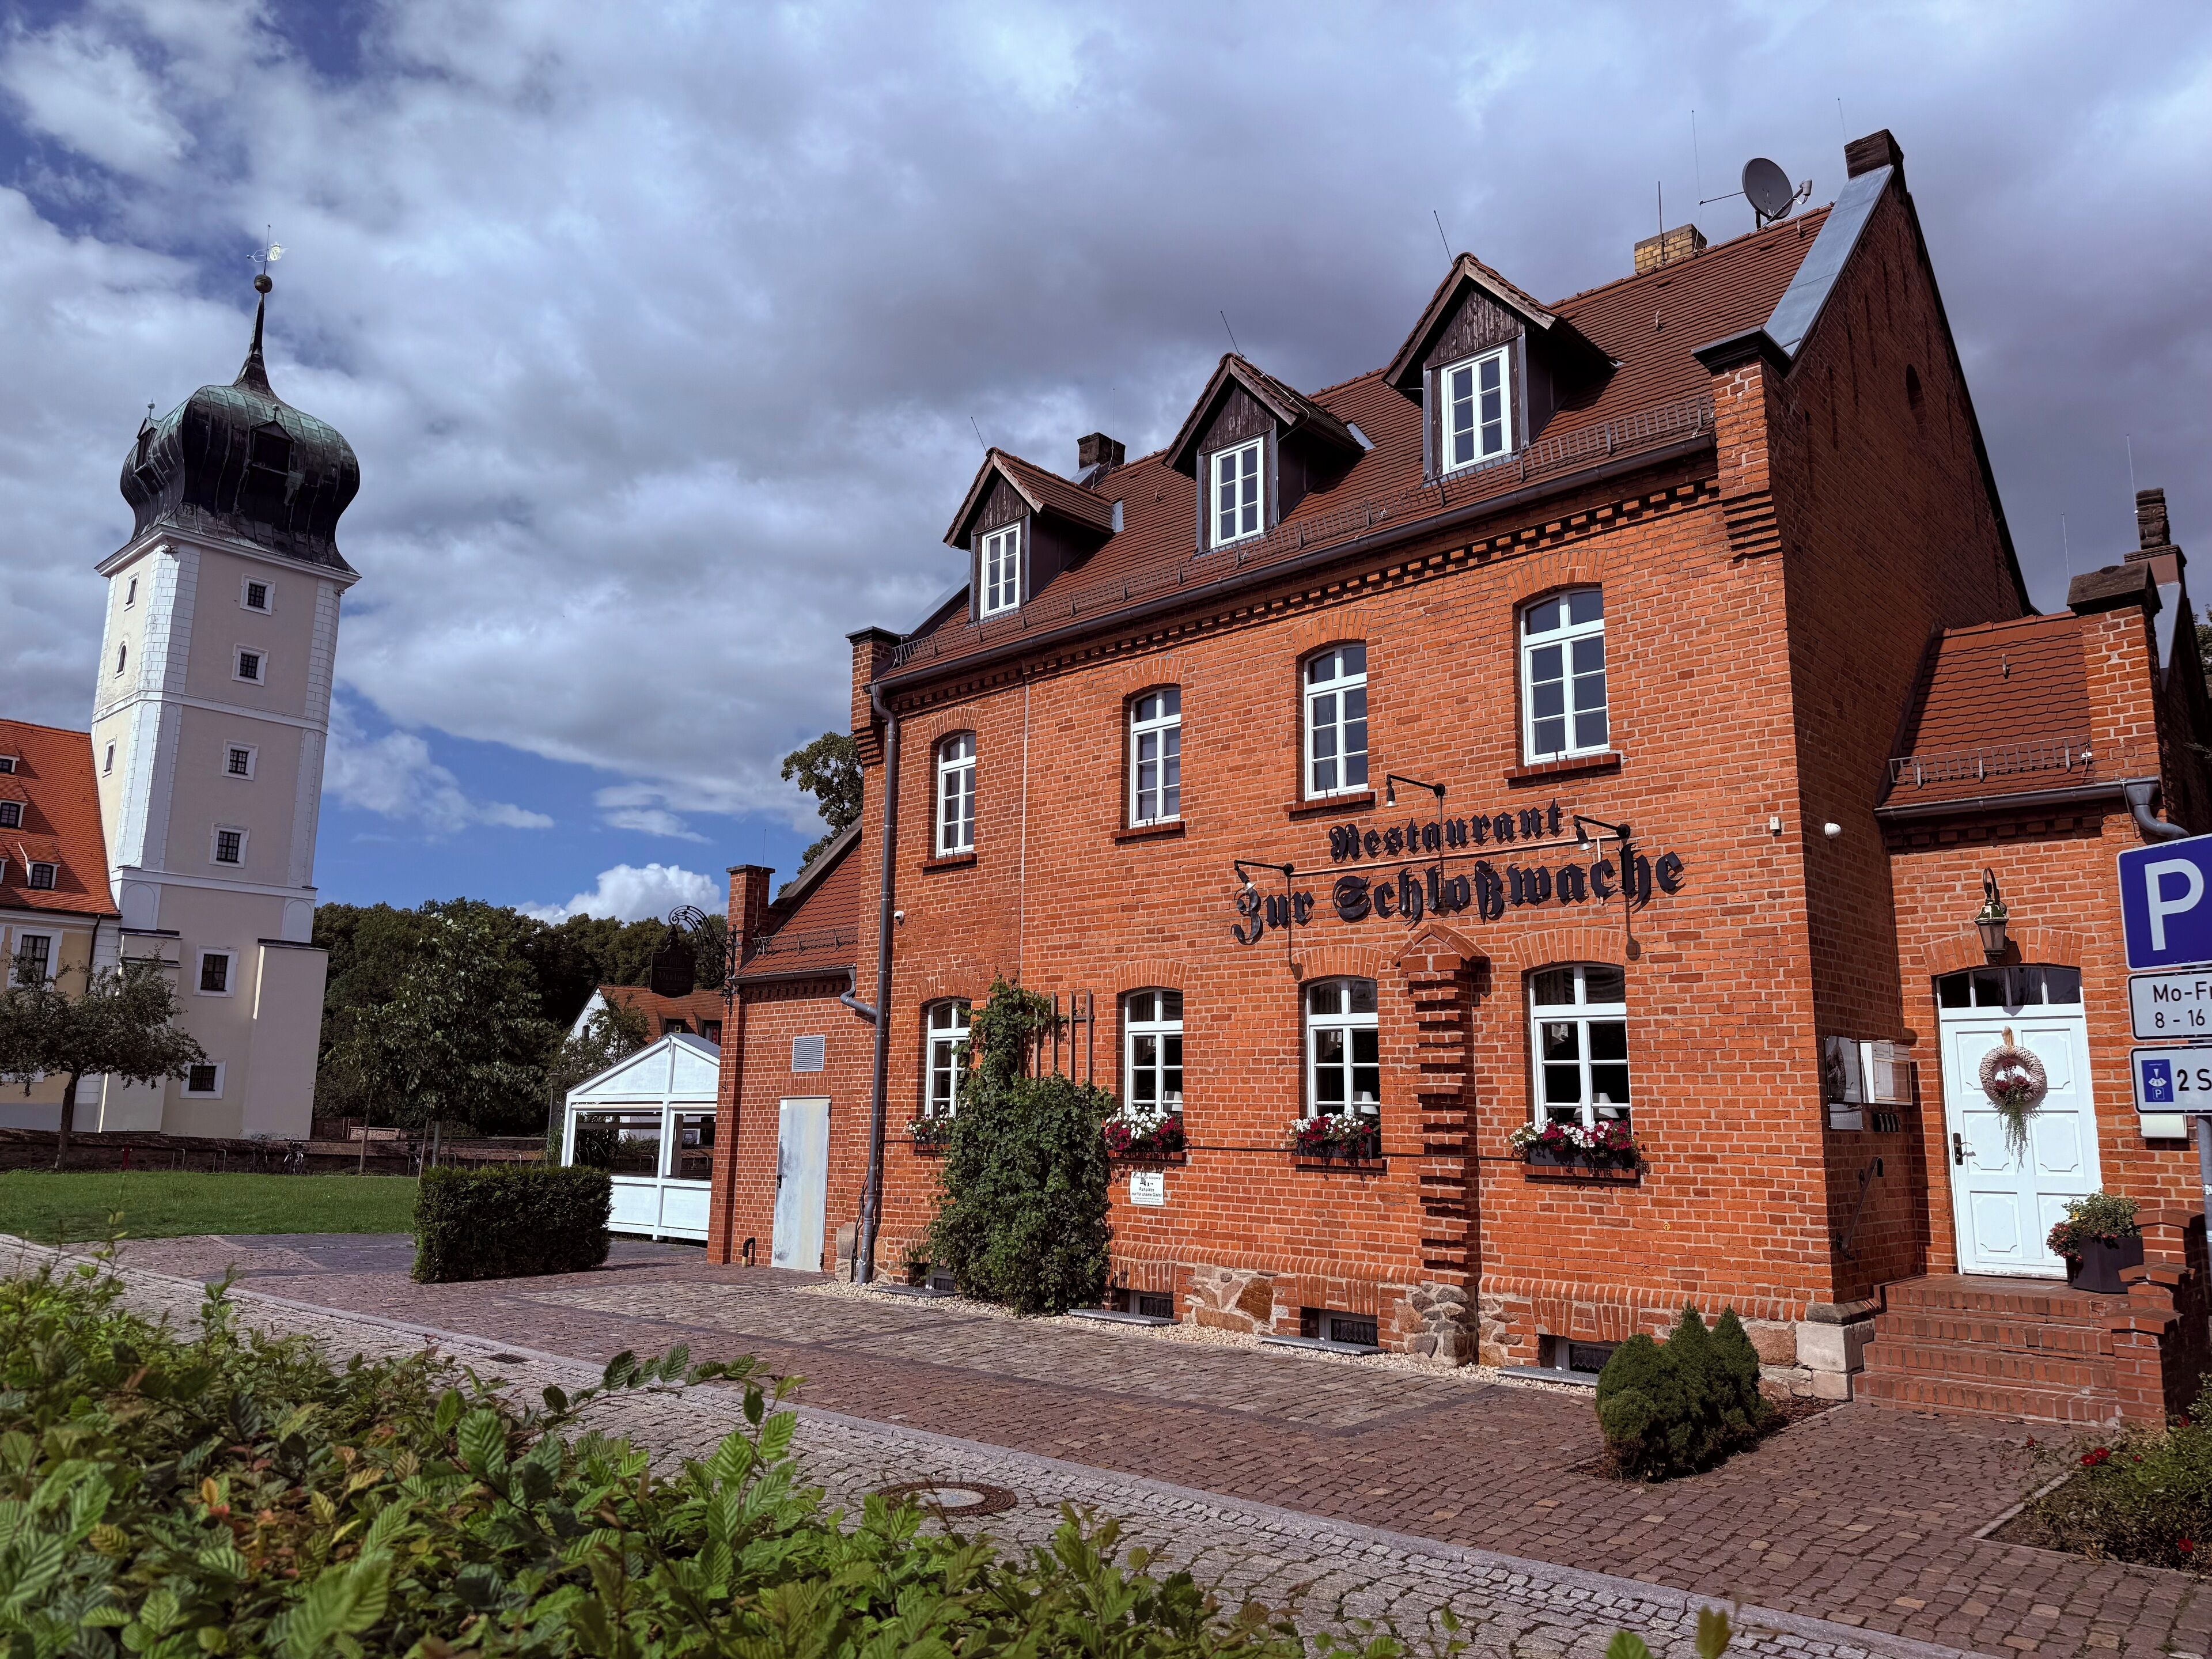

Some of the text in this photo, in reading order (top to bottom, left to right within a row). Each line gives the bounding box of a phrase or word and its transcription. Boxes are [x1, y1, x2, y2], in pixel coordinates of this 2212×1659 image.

[1329, 798, 1563, 862] Restaurant
[1231, 843, 1684, 945] Zur Schloßwache
[2144, 858, 2204, 951] P
[2155, 1012, 2165, 1029] 8
[2187, 1009, 2205, 1027] 16
[2177, 1069, 2190, 1091] 2
